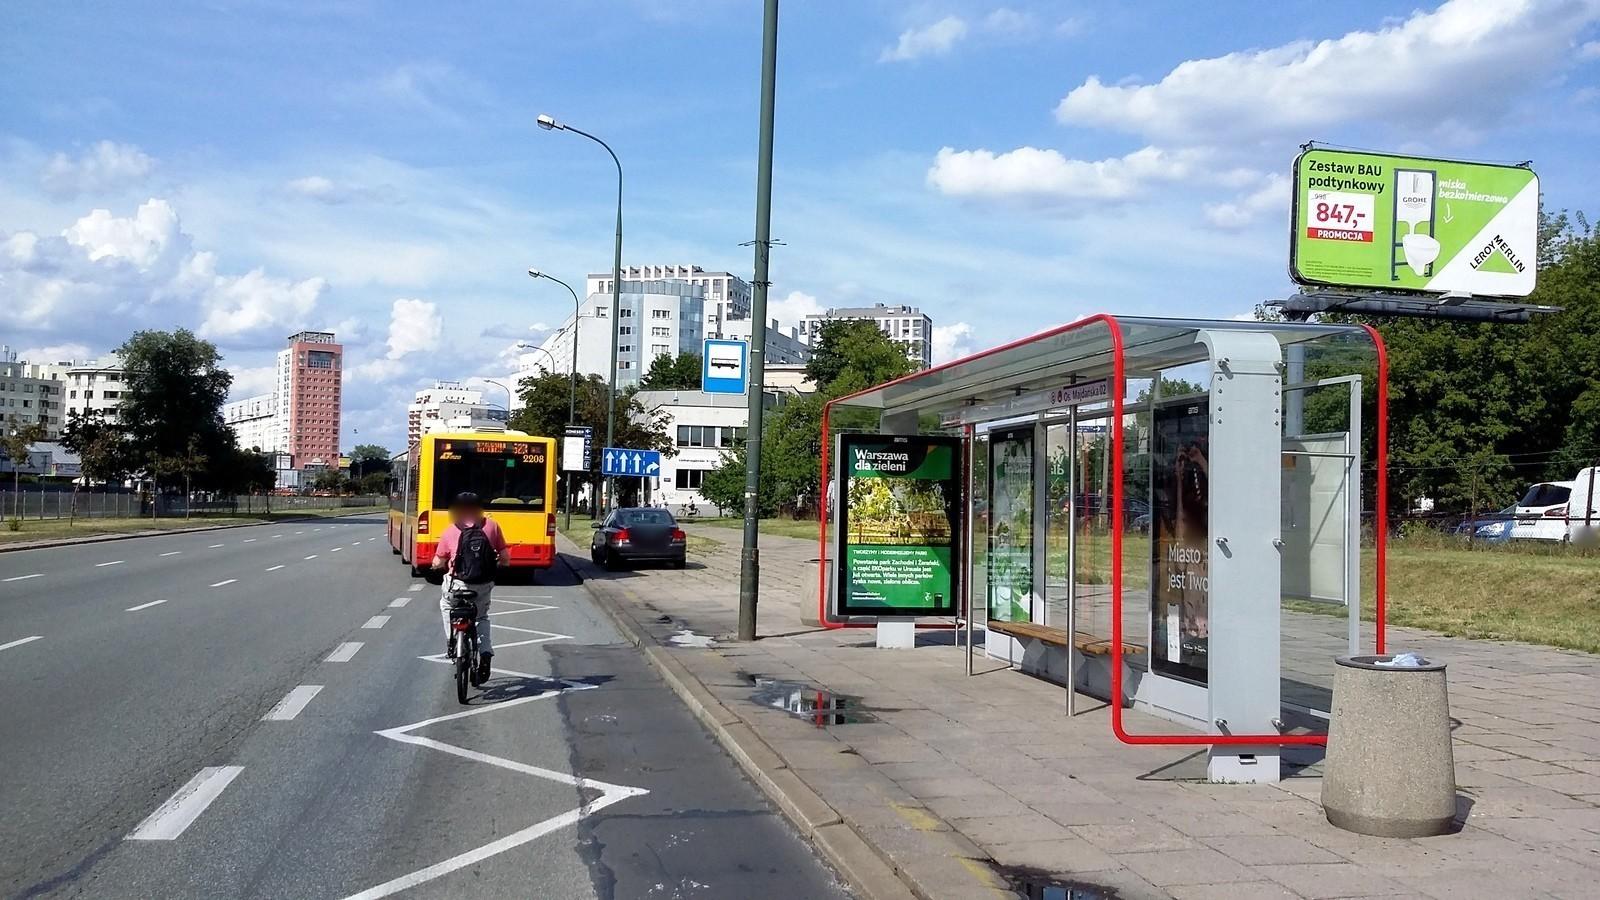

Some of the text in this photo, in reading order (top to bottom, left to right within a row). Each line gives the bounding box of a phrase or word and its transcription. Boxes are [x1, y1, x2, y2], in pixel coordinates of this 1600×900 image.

[1309, 160, 1382, 176] Zestaw BAU
[1308, 176, 1384, 194] podtynkowy
[1316, 202, 1365, 228] 847,-
[1318, 230, 1364, 240] PROMOCJA
[1470, 234, 1526, 272] LEROY MERLIN
[522, 454, 544, 463] 2208
[854, 448, 908, 460] Warszawa
[854, 460, 906, 471] dla zieleni
[1168, 542, 1200, 564] Miasto
[1167, 567, 1186, 592] jest
